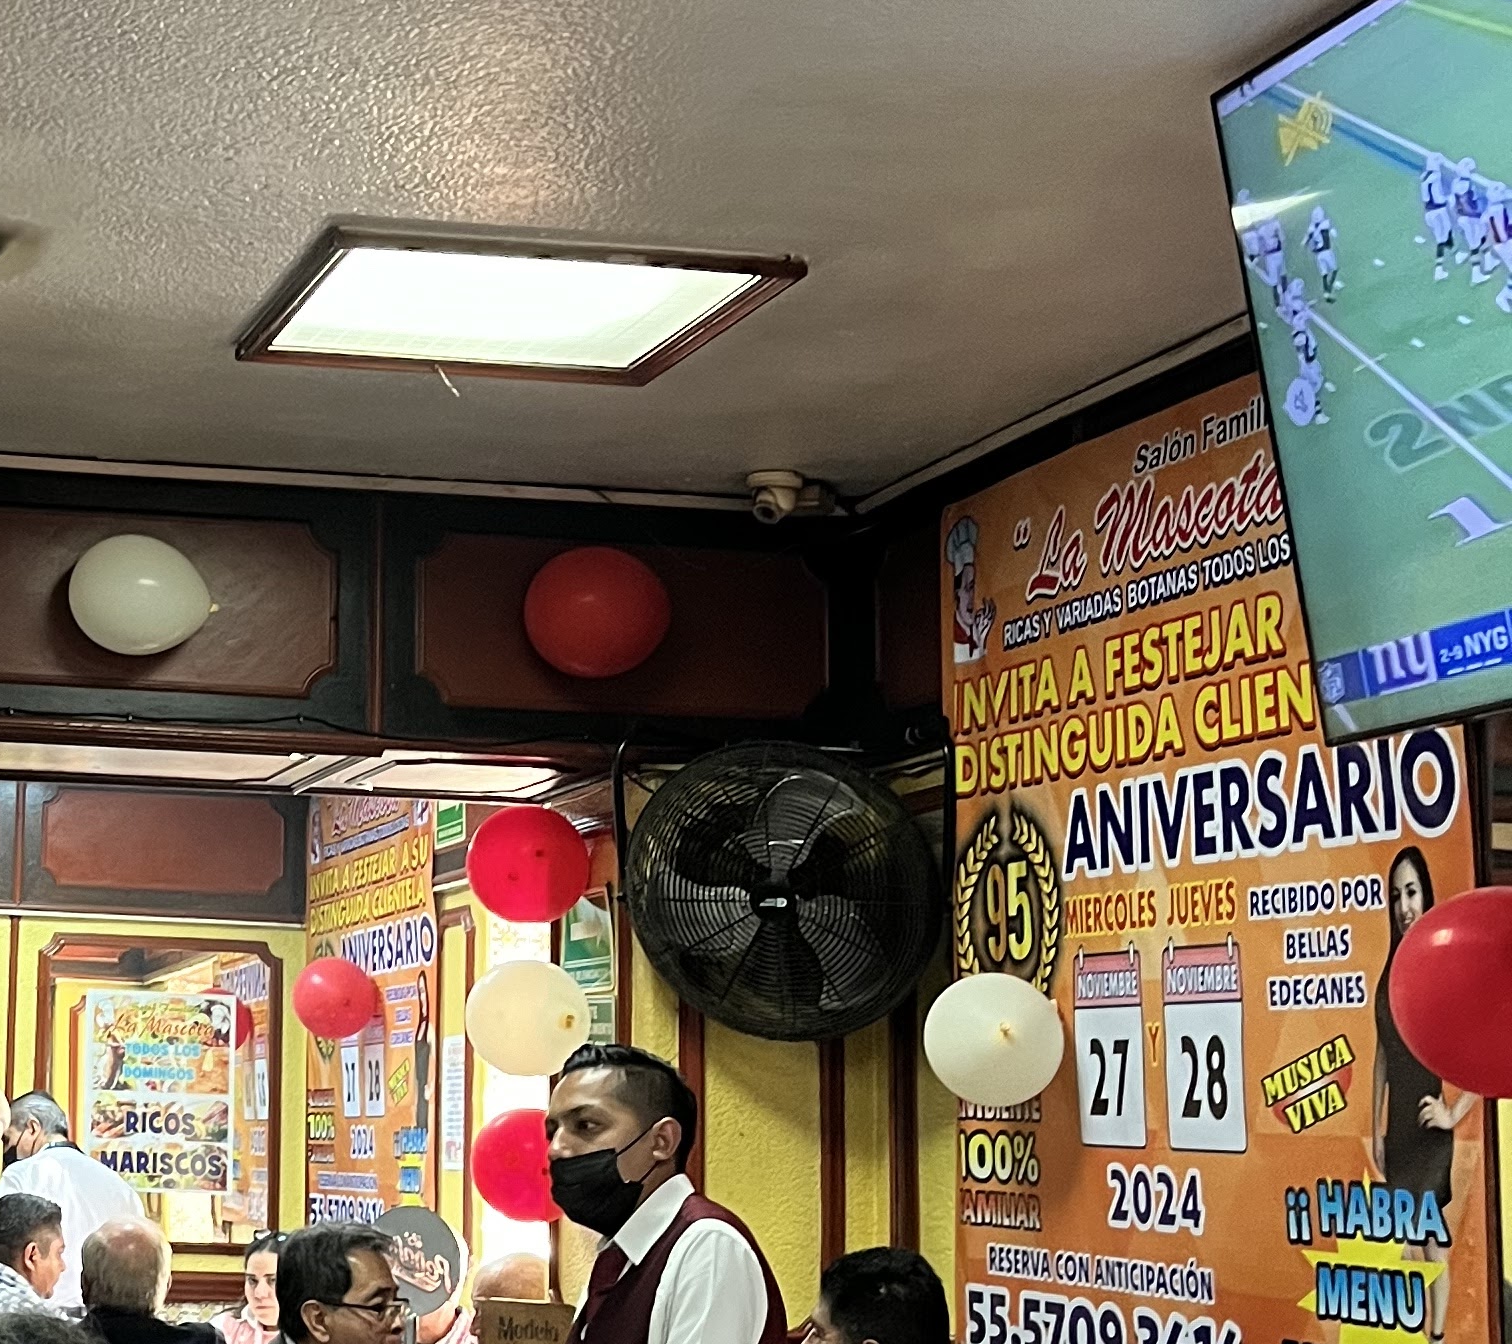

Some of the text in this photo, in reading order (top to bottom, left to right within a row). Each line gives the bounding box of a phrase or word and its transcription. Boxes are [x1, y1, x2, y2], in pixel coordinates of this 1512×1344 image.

[1133, 431, 1195, 475] Salón
[1095, 449, 1284, 574] Mascota
[1002, 533, 1291, 651] RICAS Y VARIADAS BOTANAS TODOS LOS
[954, 657, 1059, 733] INVITA
[1068, 646, 1096, 706] A
[1104, 591, 1286, 699] FESTEJAR
[1463, 625, 1509, 658] NYG
[954, 693, 1185, 796] DISTINGUIDA
[1194, 661, 1317, 750] CLIEN
[1062, 724, 1460, 880] ANIVERSARIO
[352, 845, 397, 890] FESTEJAR
[400, 842, 409, 875] A
[410, 835, 428, 870] SU
[310, 874, 426, 937] DISTINGUIDA CLIENTELA
[987, 860, 1032, 962] 95
[1064, 878, 1239, 937] MIERCOLES JUEVES
[1249, 878, 1384, 918] RECIBIDO POR
[1285, 927, 1351, 960] BELLAS
[1077, 970, 1138, 1000] NOVIEMBRE
[1166, 964, 1239, 996] NOVIEMBRE
[1268, 973, 1368, 1010] EDECANES
[124, 1041, 201, 1057] TODOS LOS
[1145, 1021, 1160, 1067] Y
[1261, 1035, 1355, 1106] MUSICA
[123, 1065, 195, 1081] DOMINGOS
[1089, 1038, 1130, 1117] 27
[1180, 1035, 1229, 1120] 28
[125, 1110, 196, 1136] RICOS
[1285, 1079, 1347, 1134] VIVA
[100, 1150, 223, 1177] MARISCOS
[960, 1131, 1039, 1184] 100%
[960, 1188, 1041, 1231] AMILIAR
[1108, 1163, 1205, 1235] 2024
[1316, 1179, 1452, 1247] HABRA
[987, 1243, 1215, 1304] RESERVA CON ANTICIPACIÓN
[1315, 1261, 1426, 1333] MENU
